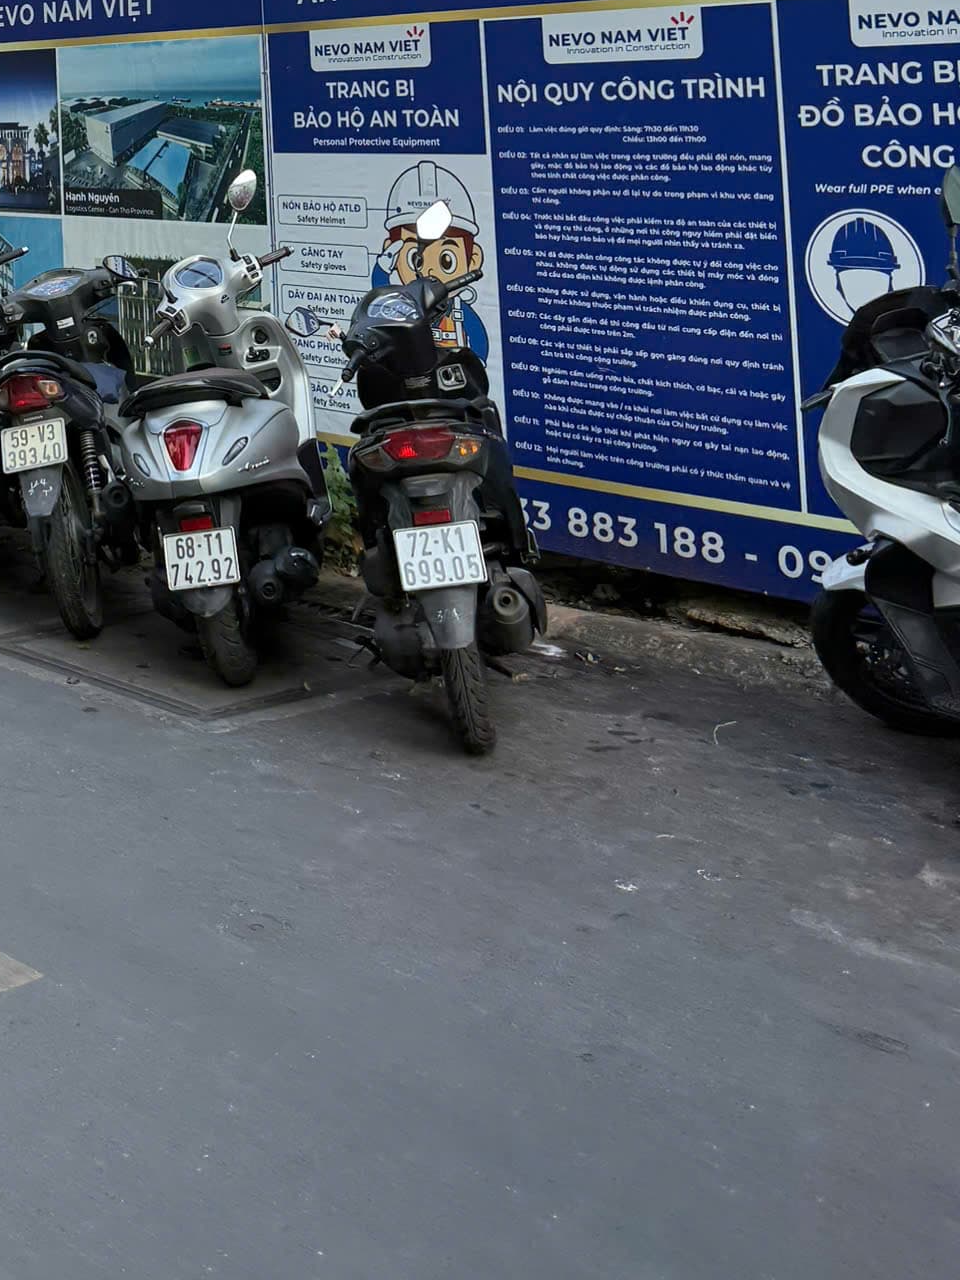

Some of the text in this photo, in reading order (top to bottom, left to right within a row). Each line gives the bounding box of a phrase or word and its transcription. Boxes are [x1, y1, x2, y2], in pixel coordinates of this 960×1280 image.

[858, 11, 919, 29] NEVO
[548, 26, 688, 47] NEVO NAM VIET
[882, 27, 944, 37] Innovation
[314, 39, 421, 57] NEVO NAM VIET
[372, 53, 421, 61] Construction
[566, 46, 614, 54] Innovation
[625, 43, 690, 52] Construction
[815, 61, 922, 86] TRANG
[325, 79, 414, 101] TRANG BỊ
[497, 72, 764, 107] NỘI QUY CÔNG TRÌNH
[293, 104, 459, 132] BẢO HỘ AN TOÀN
[797, 95, 922, 126] ĐỒ BẢO
[313, 136, 440, 147] Personal Protective Equipment
[862, 139, 954, 170] CÔNG
[815, 183, 846, 193] Wear
[848, 183, 867, 193] full
[870, 184, 894, 193] PPE
[897, 184, 931, 196] when
[282, 200, 361, 213] NÓN BẢO HỘ ATLĐ
[297, 215, 346, 224] Safety Helmet
[300, 246, 343, 258] GĂNG TAY
[299, 260, 346, 272] Safety gloves
[288, 289, 305, 299] DÂY
[307, 292, 322, 301] ĐAI
[324, 293, 337, 302] AN
[308, 305, 345, 315] Safety belt
[300, 353, 350, 364] Safety Clothin
[329, 399, 350, 409] Shoes
[11, 424, 55, 448] 59-V3
[8, 442, 62, 469] 393.40
[406, 527, 464, 557] 72-K1
[567, 507, 830, 589] 883 188 09
[171, 557, 234, 586] 742.92
[404, 554, 480, 586] 699.05
